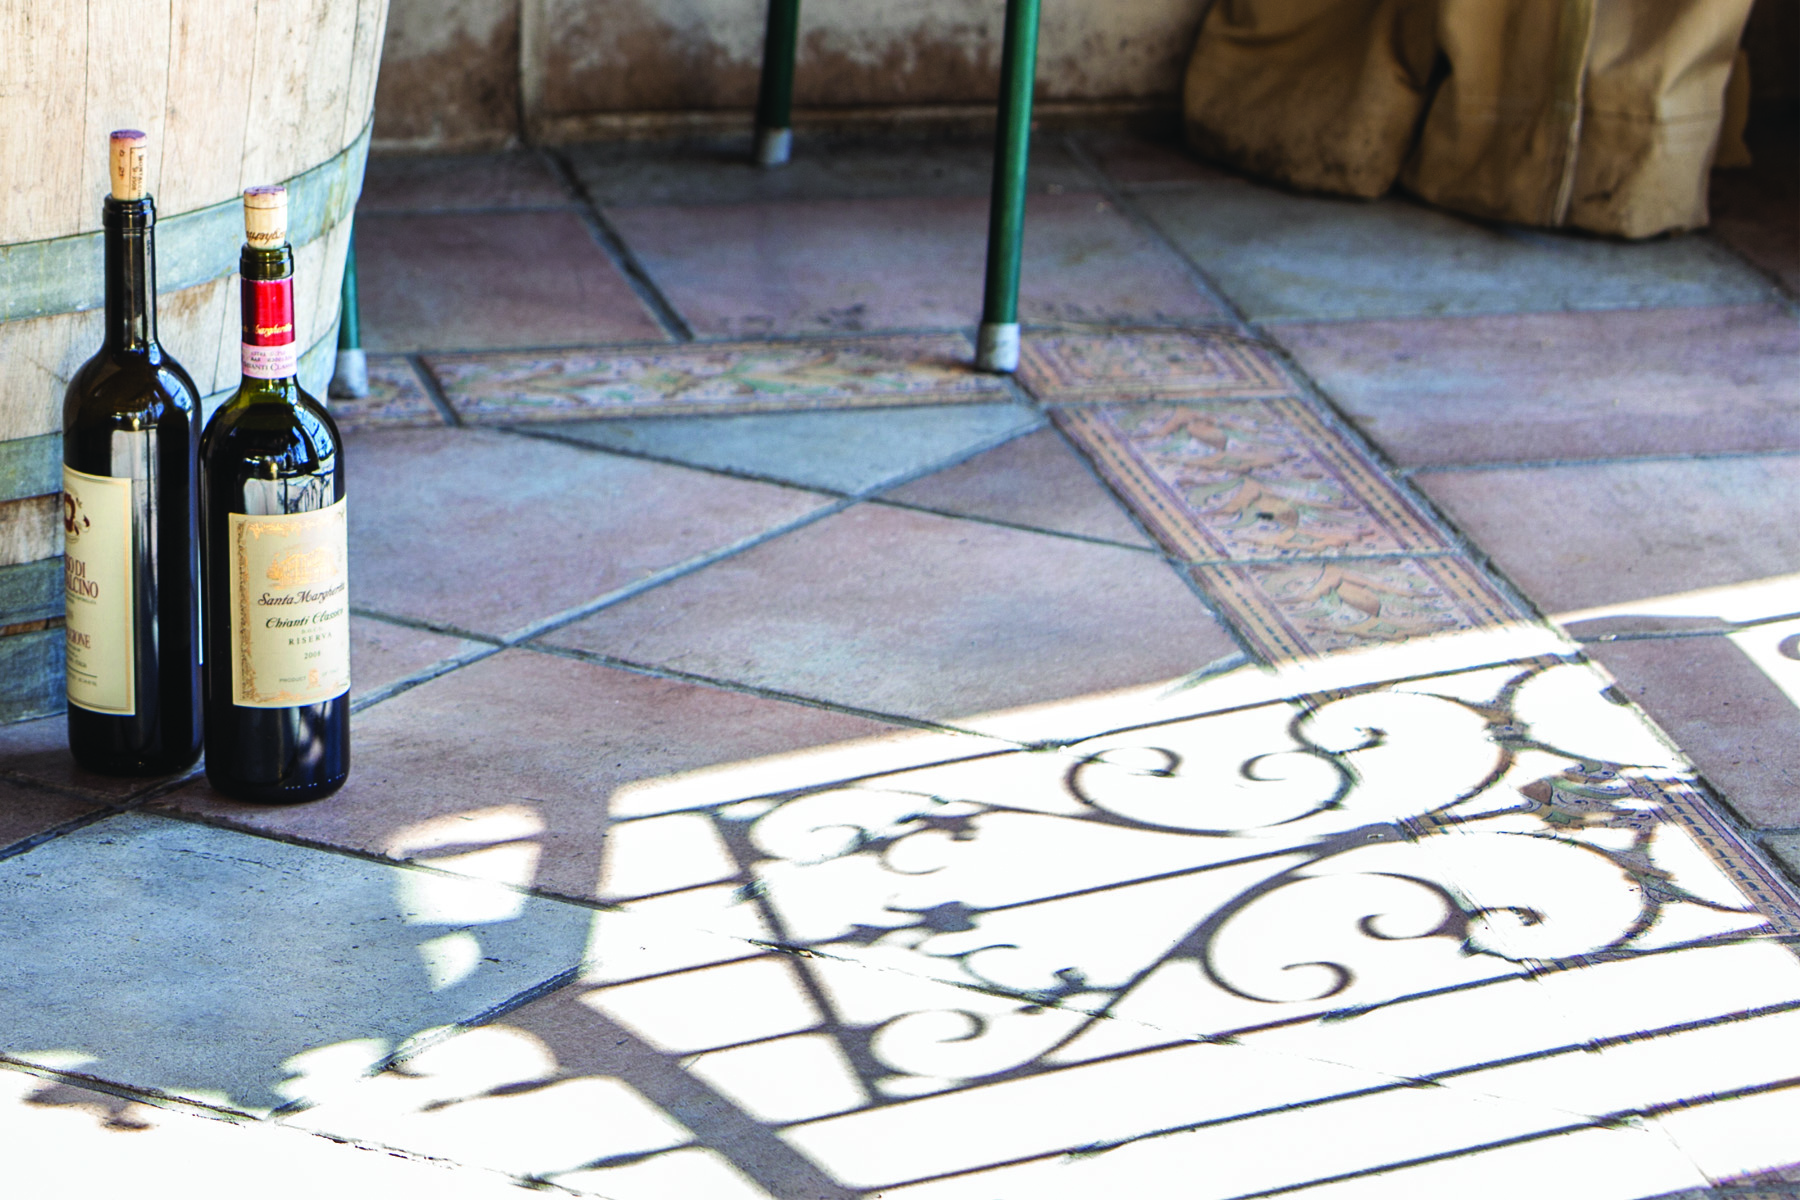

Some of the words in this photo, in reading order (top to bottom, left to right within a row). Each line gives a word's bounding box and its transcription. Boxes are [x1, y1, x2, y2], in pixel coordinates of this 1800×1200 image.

[257, 592, 295, 607] Santa
[265, 615, 310, 629] Chianti
[288, 632, 332, 645] RISERVA
